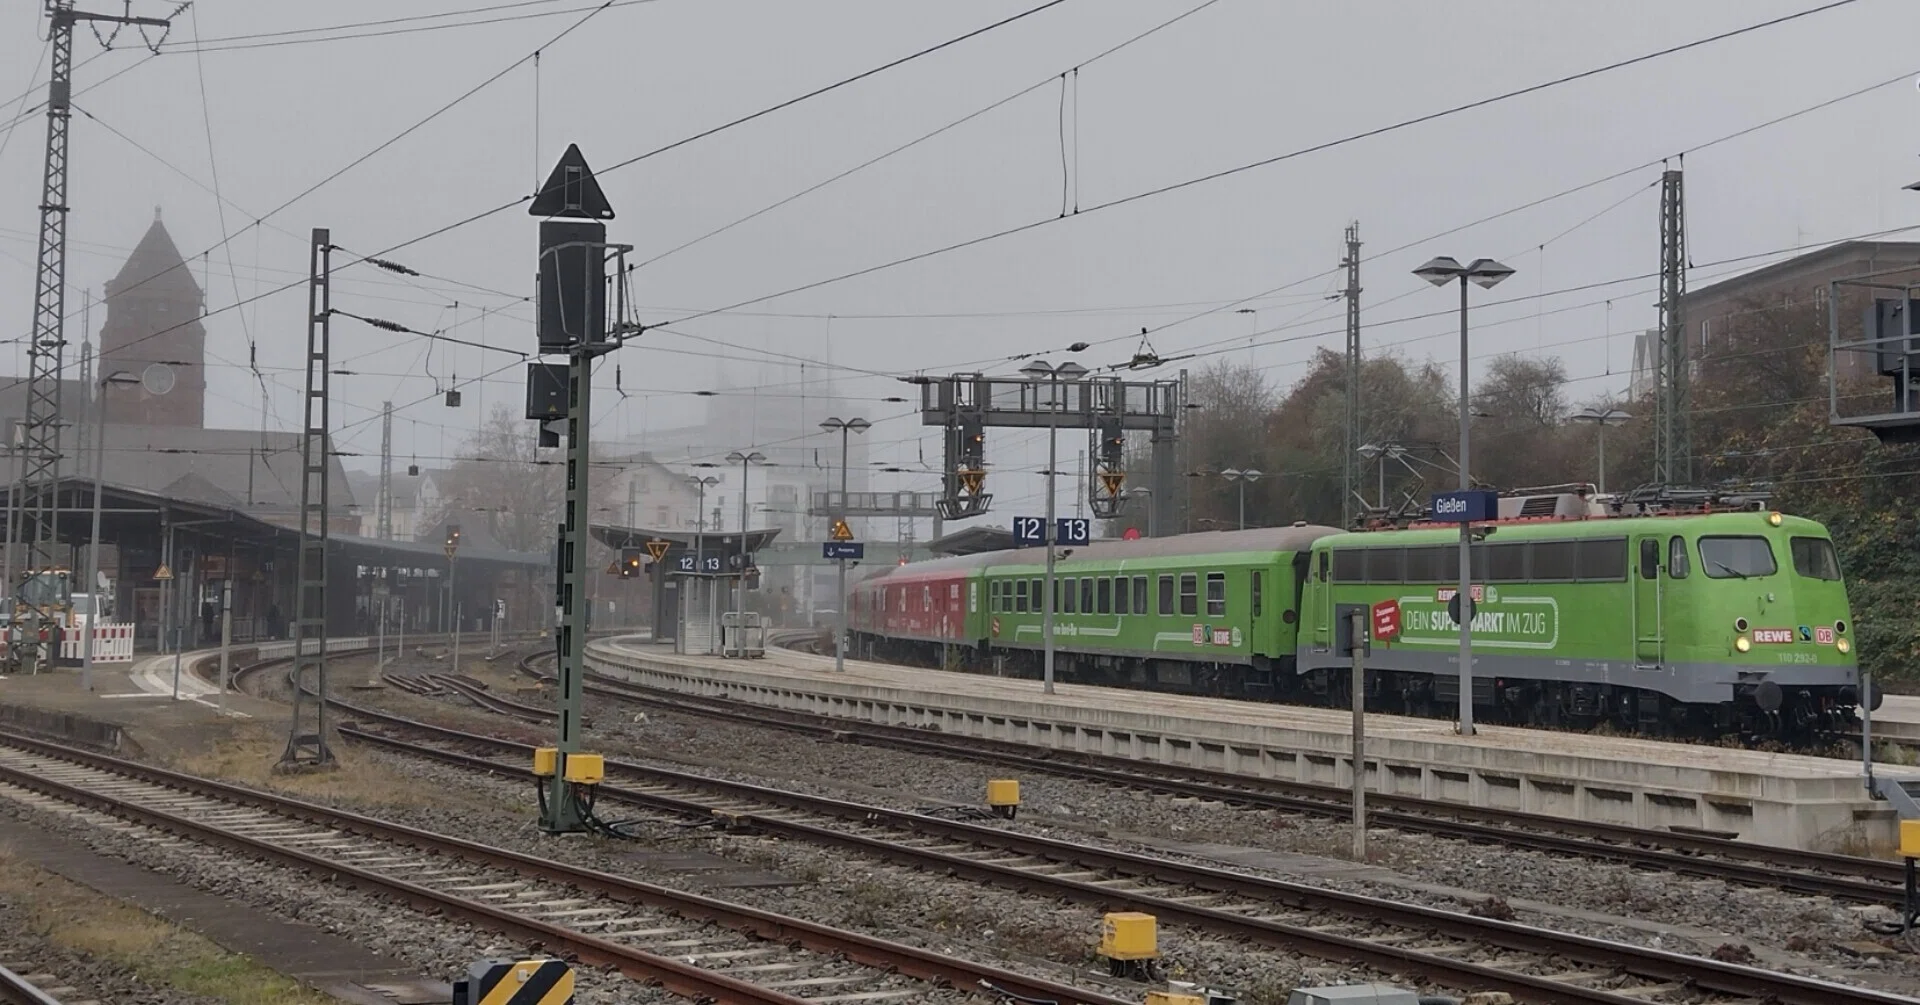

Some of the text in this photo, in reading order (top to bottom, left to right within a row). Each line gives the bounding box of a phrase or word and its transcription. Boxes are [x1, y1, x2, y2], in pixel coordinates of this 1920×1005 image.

[1436, 498, 1467, 513] Gießen
[1017, 518, 1040, 539] 12
[1064, 519, 1086, 540] 13
[680, 557, 693, 569] 12
[706, 557, 719, 569] 13
[1406, 610, 1429, 630] DEIN
[1431, 610, 1505, 633] SUPEMARKT
[1506, 613, 1520, 633] IM
[1522, 613, 1546, 634] ZUG
[1754, 630, 1792, 642] REWE
[1818, 629, 1832, 641] DB
